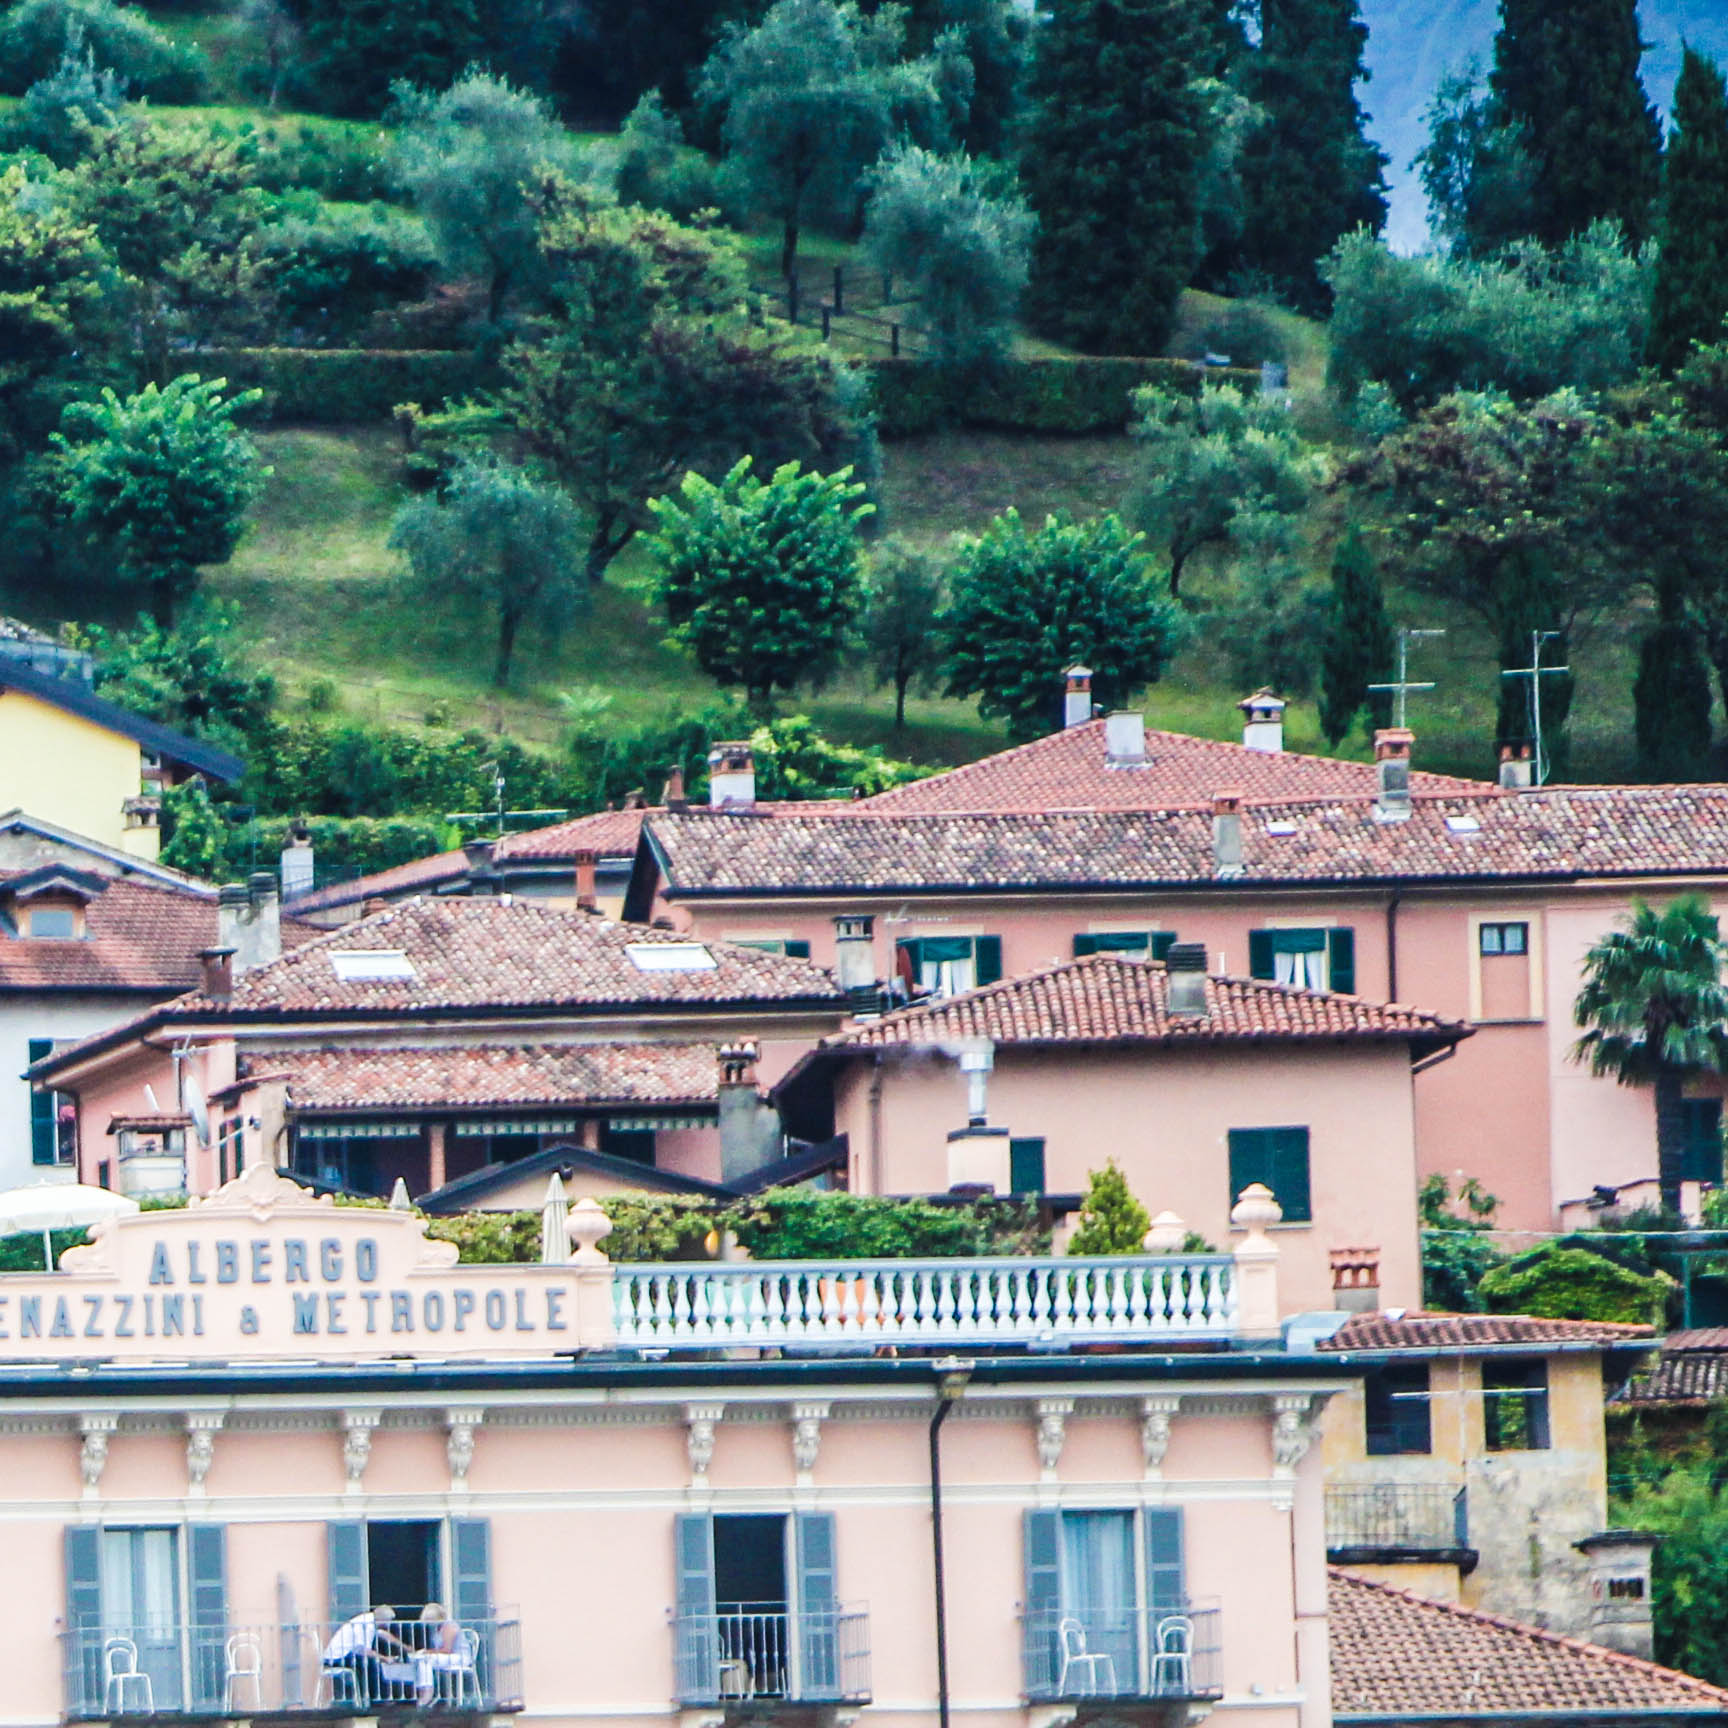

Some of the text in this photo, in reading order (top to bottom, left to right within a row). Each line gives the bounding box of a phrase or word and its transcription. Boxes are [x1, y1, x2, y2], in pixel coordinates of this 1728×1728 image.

[148, 1236, 379, 1285] ALBERGO
[239, 1303, 260, 1336] &
[292, 1286, 568, 1335] METROPOLE
